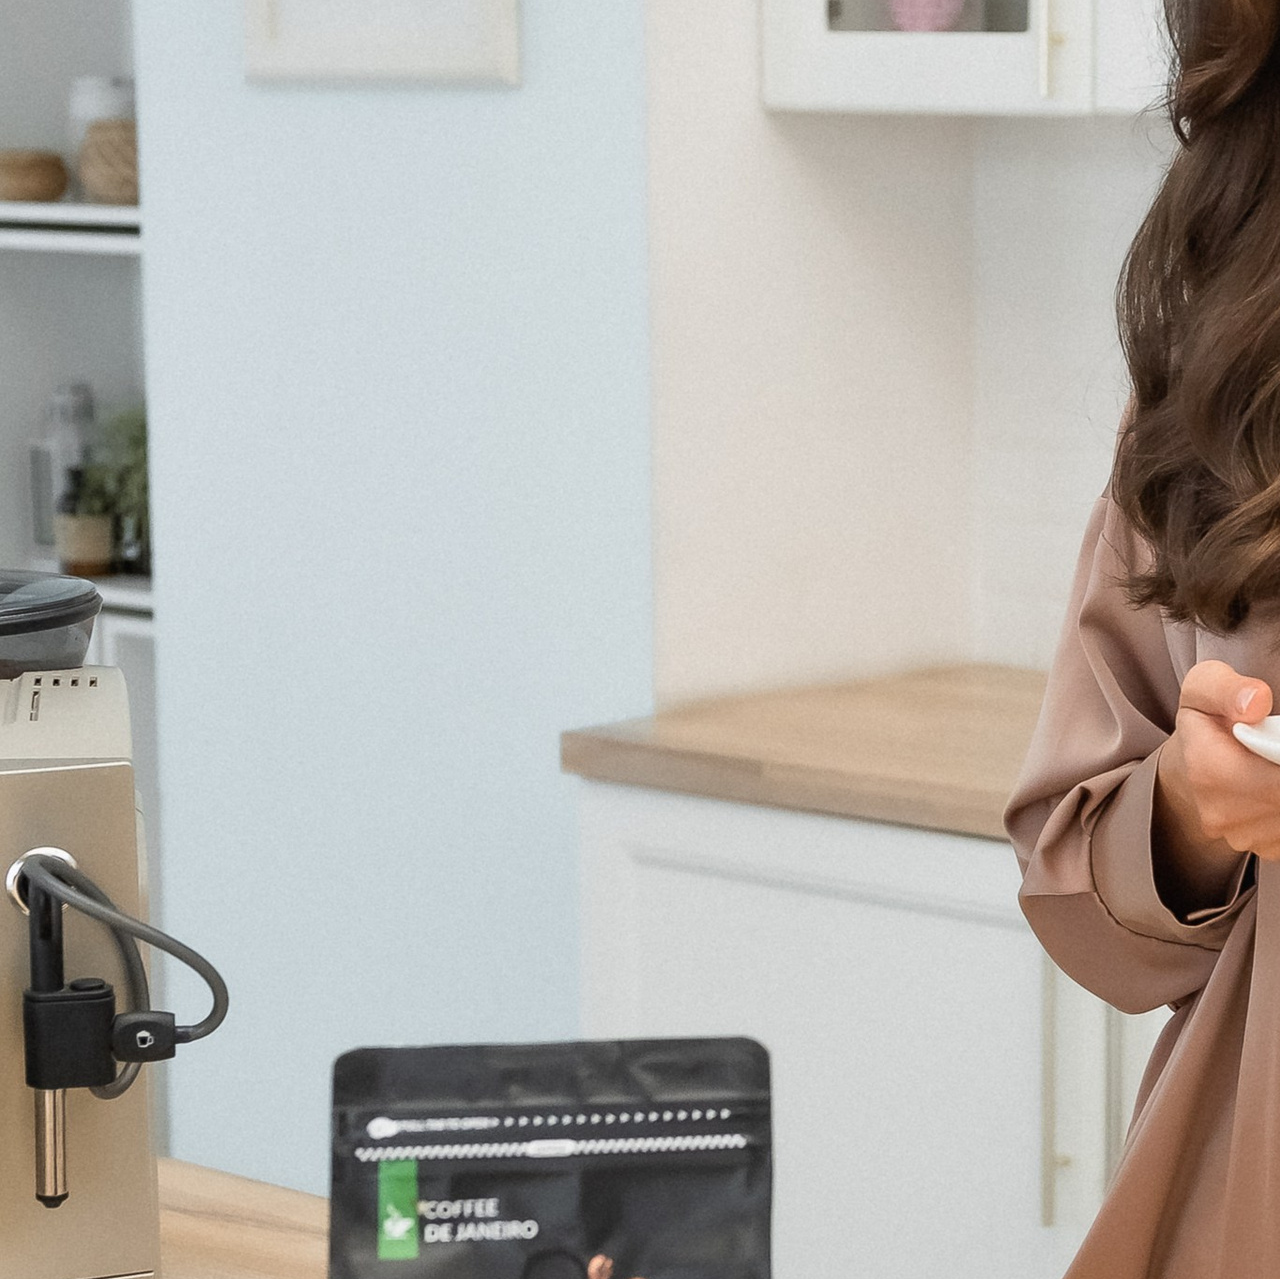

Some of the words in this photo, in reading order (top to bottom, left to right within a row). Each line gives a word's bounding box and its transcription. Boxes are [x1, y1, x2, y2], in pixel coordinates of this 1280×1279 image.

[424, 1198, 499, 1219] COFFEE
[424, 1223, 452, 1242] DE
[455, 1220, 539, 1241] JANEIRO
